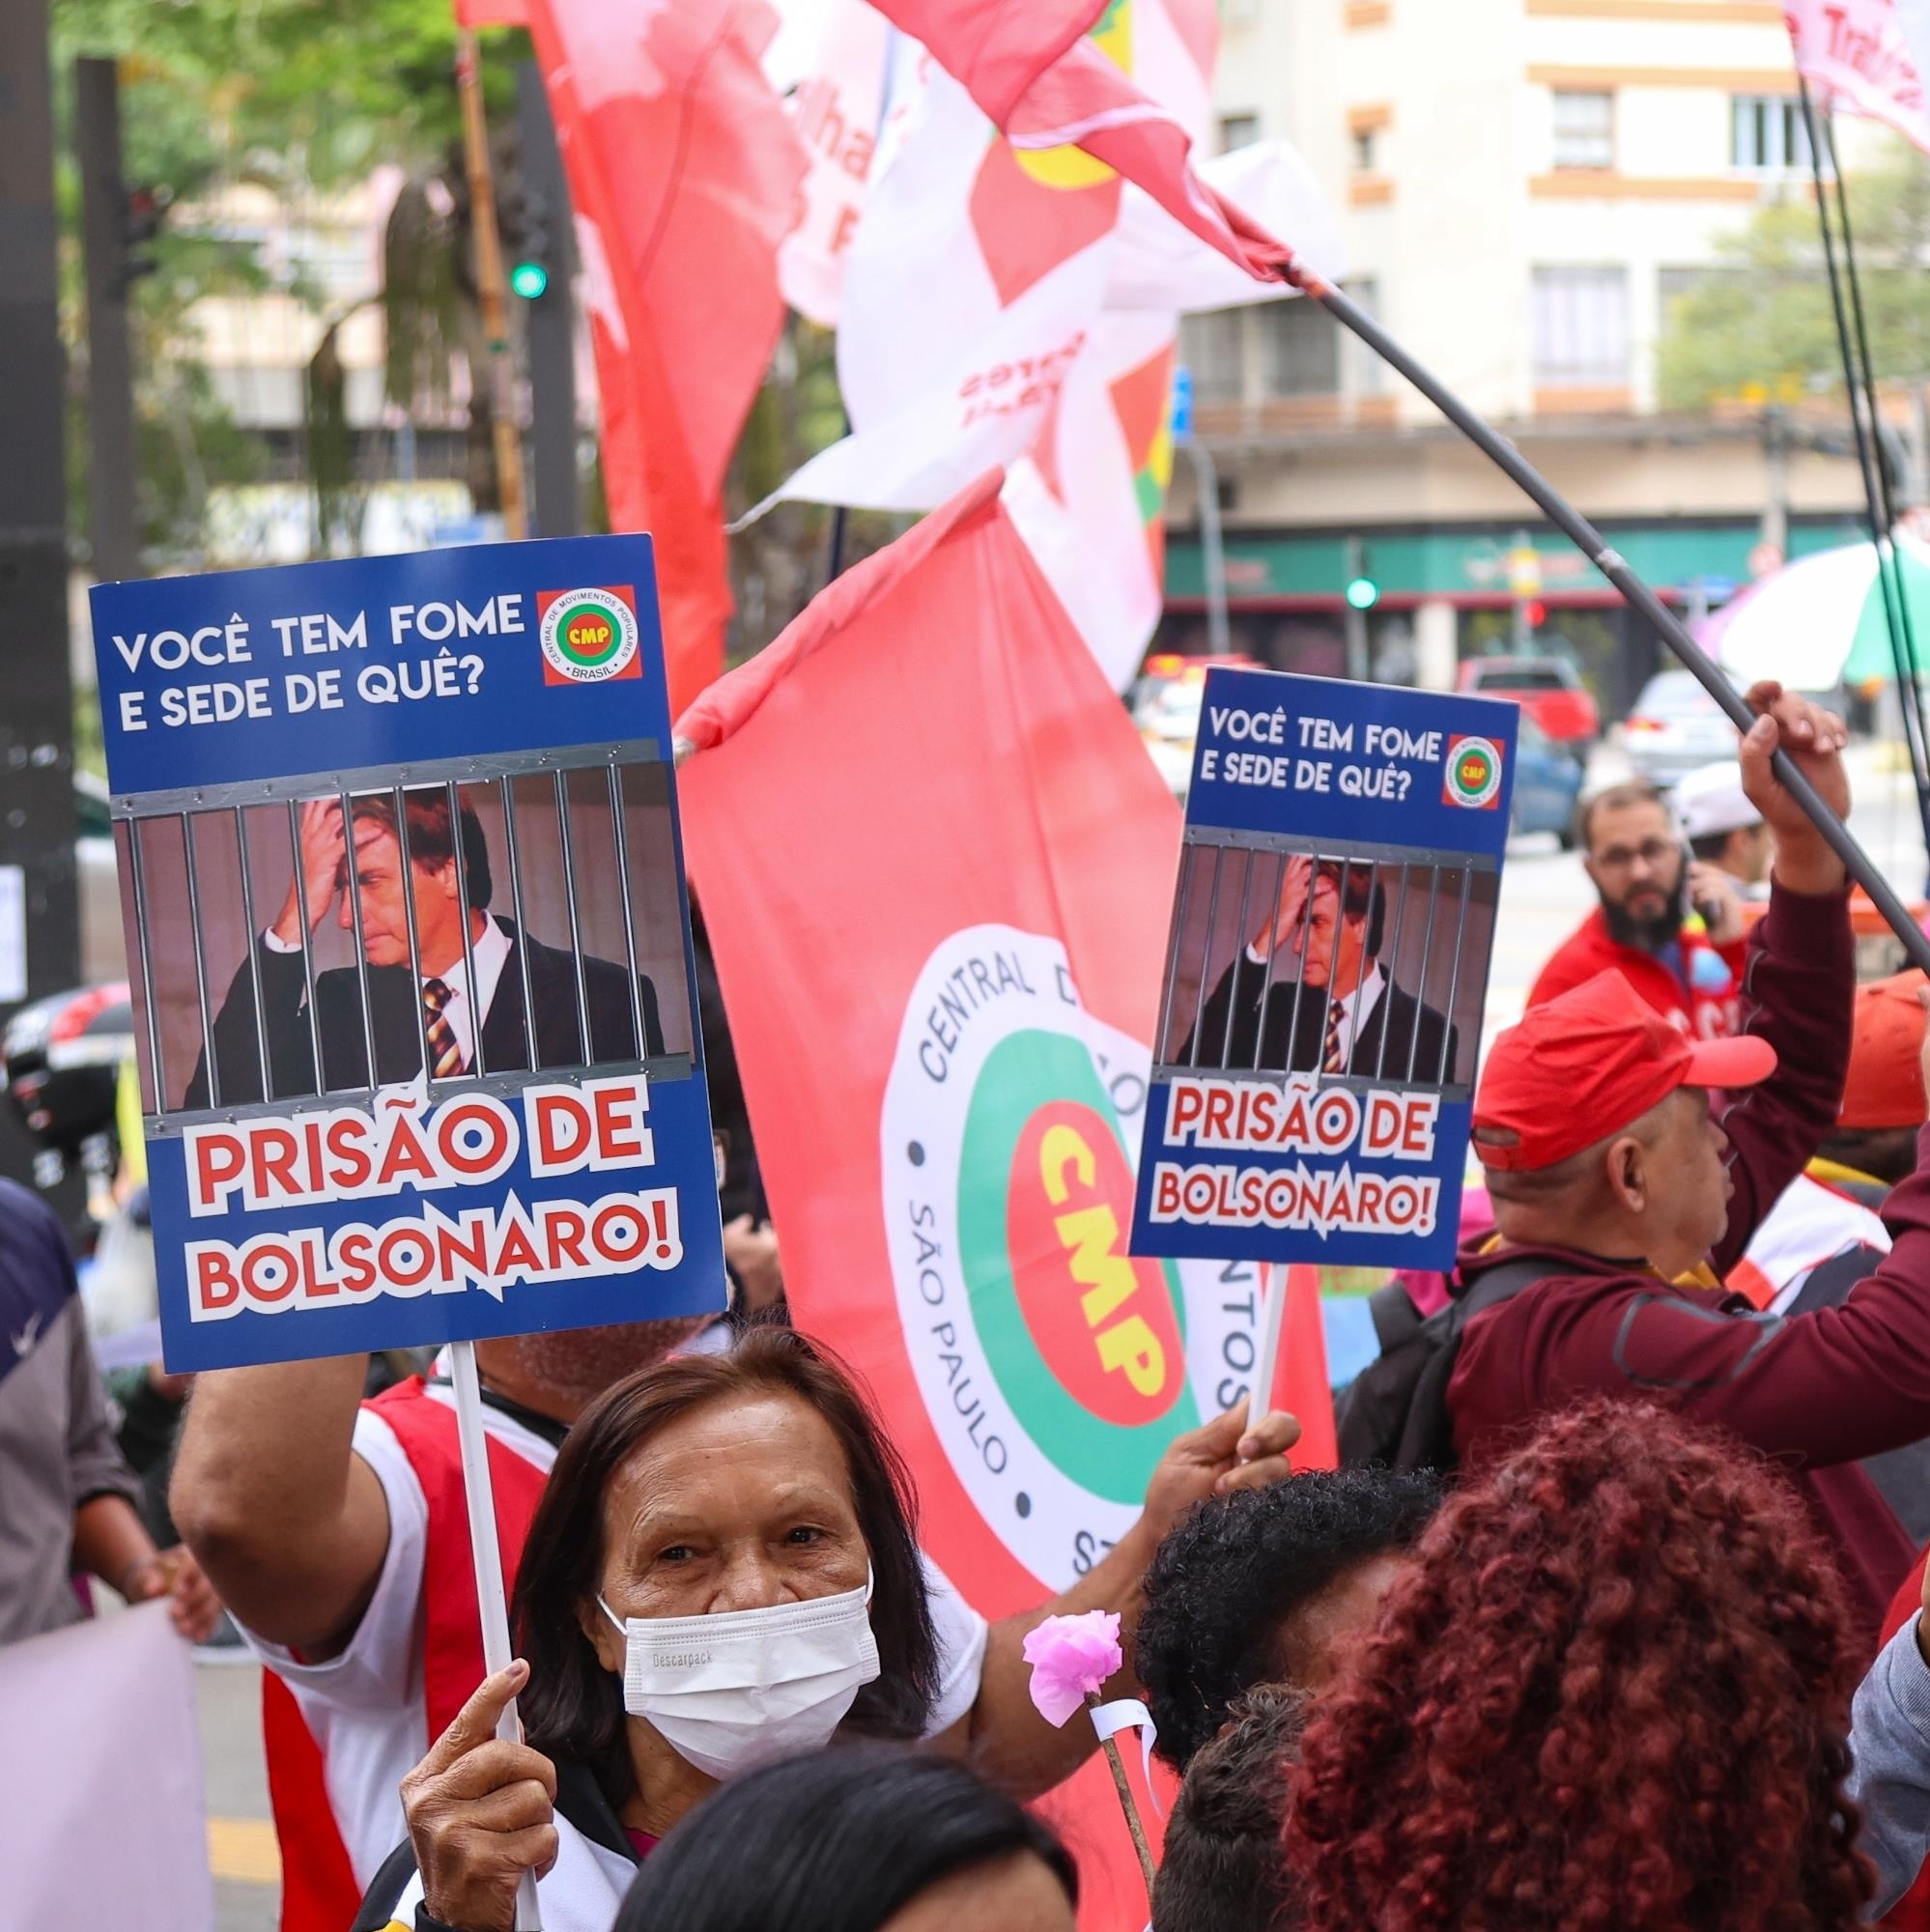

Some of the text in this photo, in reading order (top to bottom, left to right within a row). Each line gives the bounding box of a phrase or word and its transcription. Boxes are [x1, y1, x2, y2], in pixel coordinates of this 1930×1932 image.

[112, 593, 525, 673] VOCÊ TEM FOME
[544, 591, 634, 664] CENTRAL DE MOVIMENTOS POPULARES
[568, 625, 610, 645] CMP
[118, 646, 485, 732] E SEDE DE QUÊ?
[571, 666, 614, 679] BRASIL
[1208, 705, 1442, 762] VOCÊ TEM FOME
[1200, 749, 1220, 781] E
[1223, 752, 1290, 788] SEDE
[1294, 758, 1333, 793] DE
[1338, 760, 1412, 802] QUÊ?
[1462, 764, 1486, 780] CMP
[918, 949, 1036, 1085] CENTRAL
[193, 1085, 644, 1207] PRISÃO DE
[1170, 1081, 1355, 1148] PRISÃO
[1366, 1097, 1433, 1152] DE
[1155, 1170, 1433, 1230] BOLSONARO!
[194, 1199, 673, 1312] BOLSONARO!
[1038, 1122, 1167, 1398] CMP
[908, 1199, 1008, 1476] SÃO PAULO
[652, 1649, 714, 1668] Descarpack
